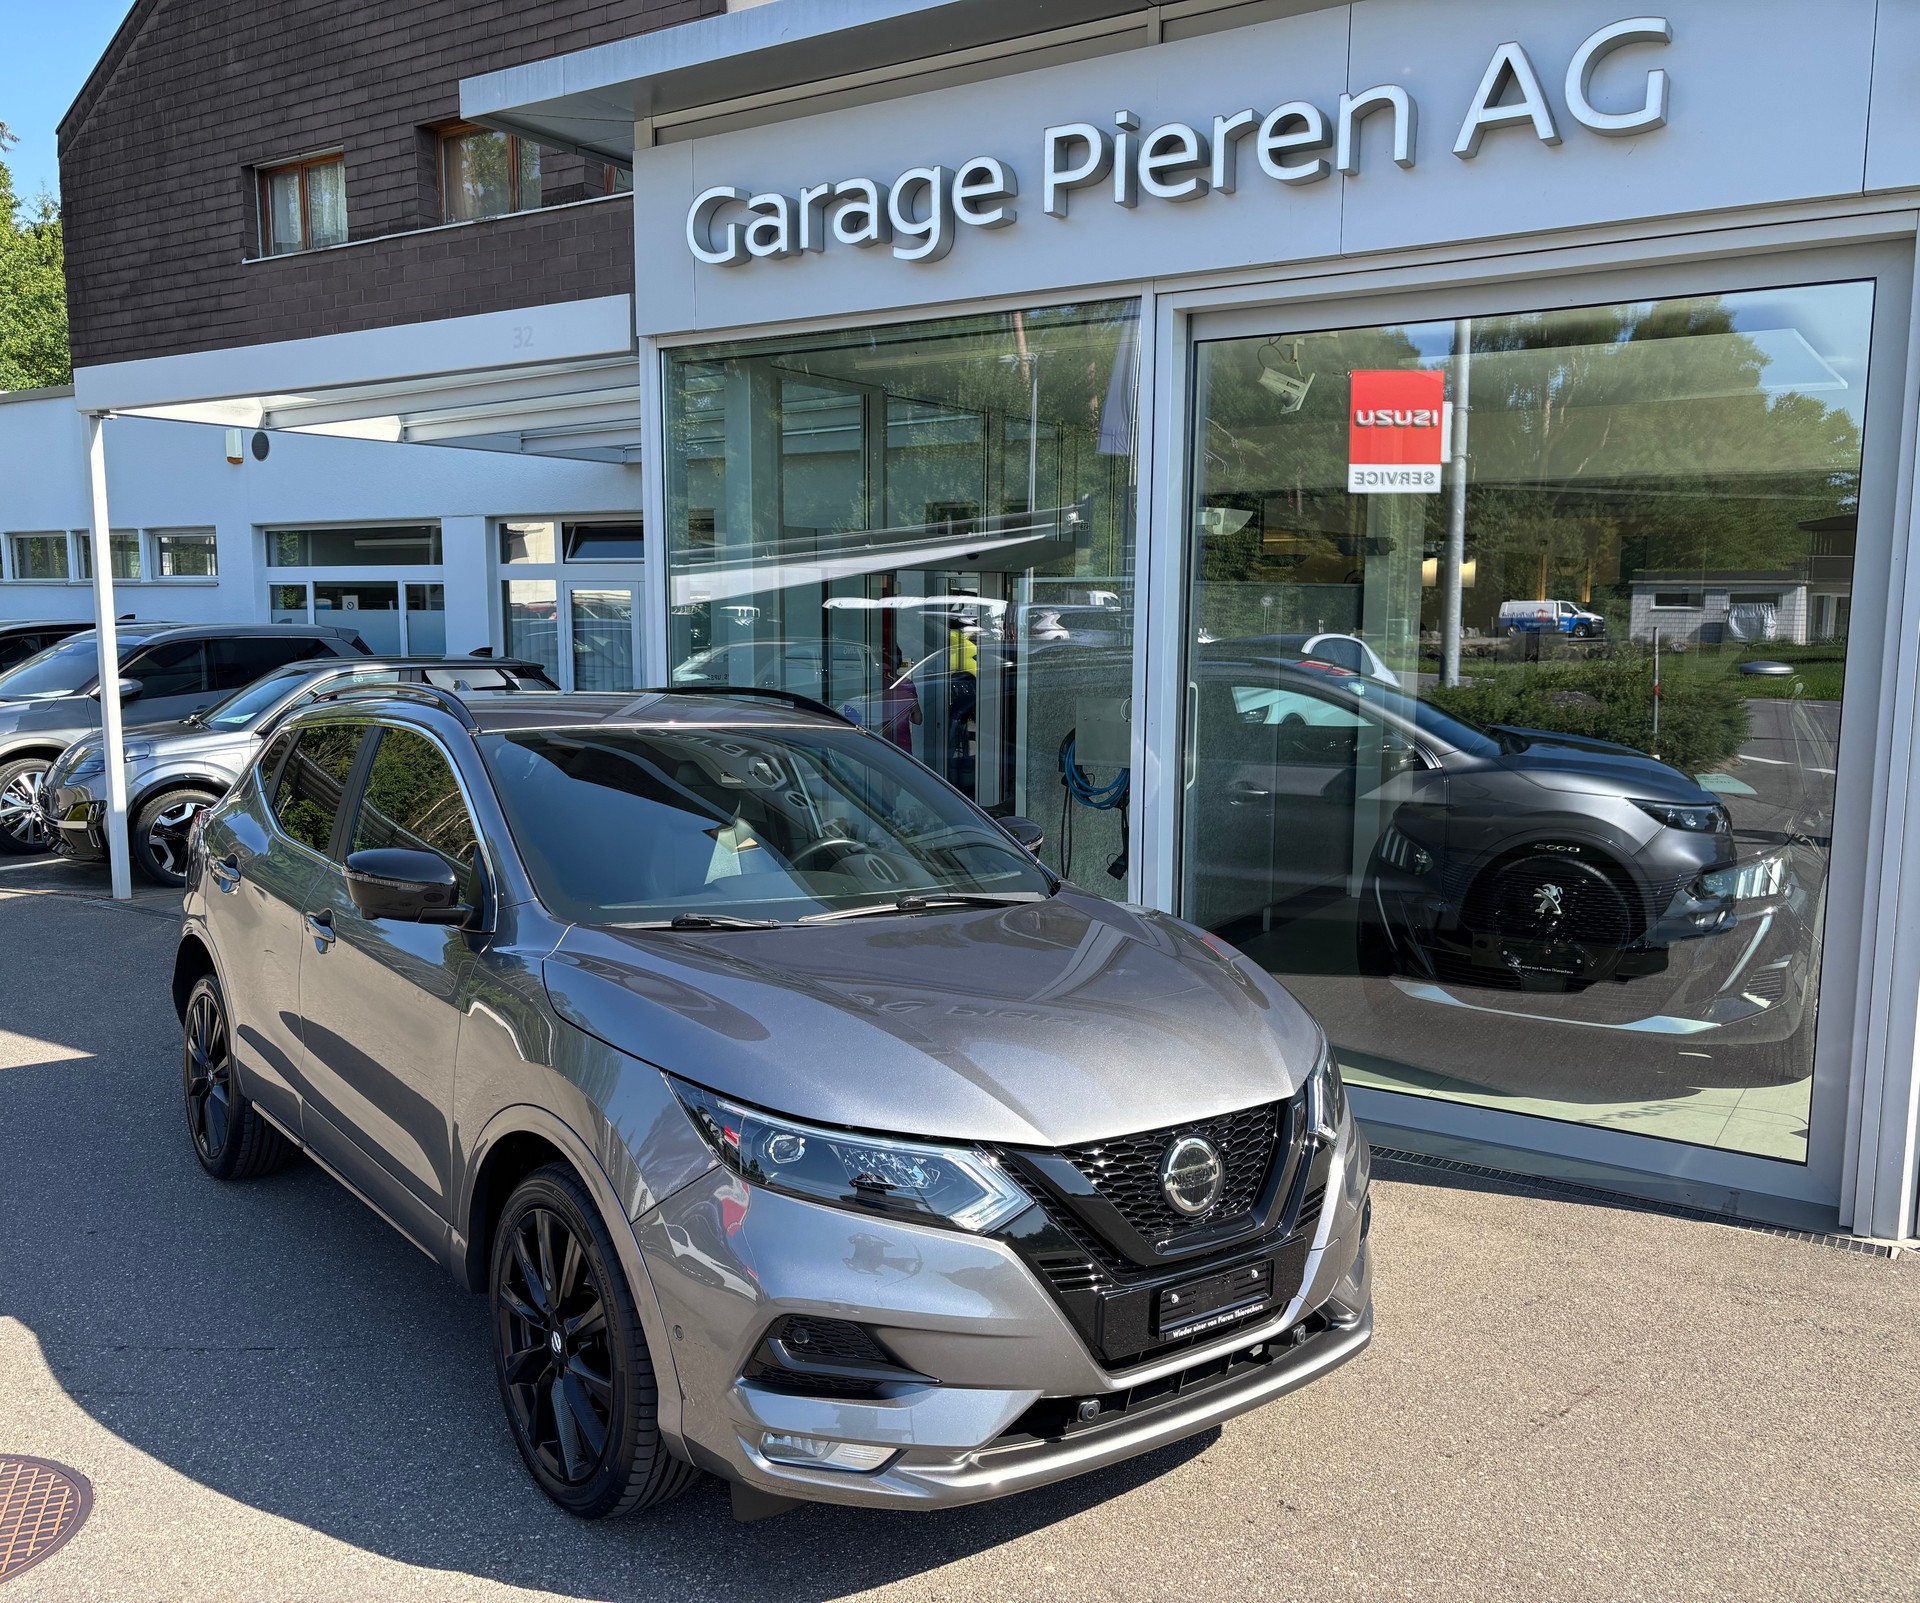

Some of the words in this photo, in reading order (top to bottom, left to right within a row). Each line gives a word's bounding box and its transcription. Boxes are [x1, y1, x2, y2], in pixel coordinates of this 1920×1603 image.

[686, 156, 1017, 267] Garage
[1043, 83, 1418, 218] Pieren
[1452, 17, 1673, 159] AG
[512, 325, 535, 349] 32
[1172, 1327, 1192, 1339] Wieder
[1193, 1322, 1207, 1332] einer
[1207, 1318, 1217, 1327] von
[1217, 1313, 1234, 1324] Pieren
